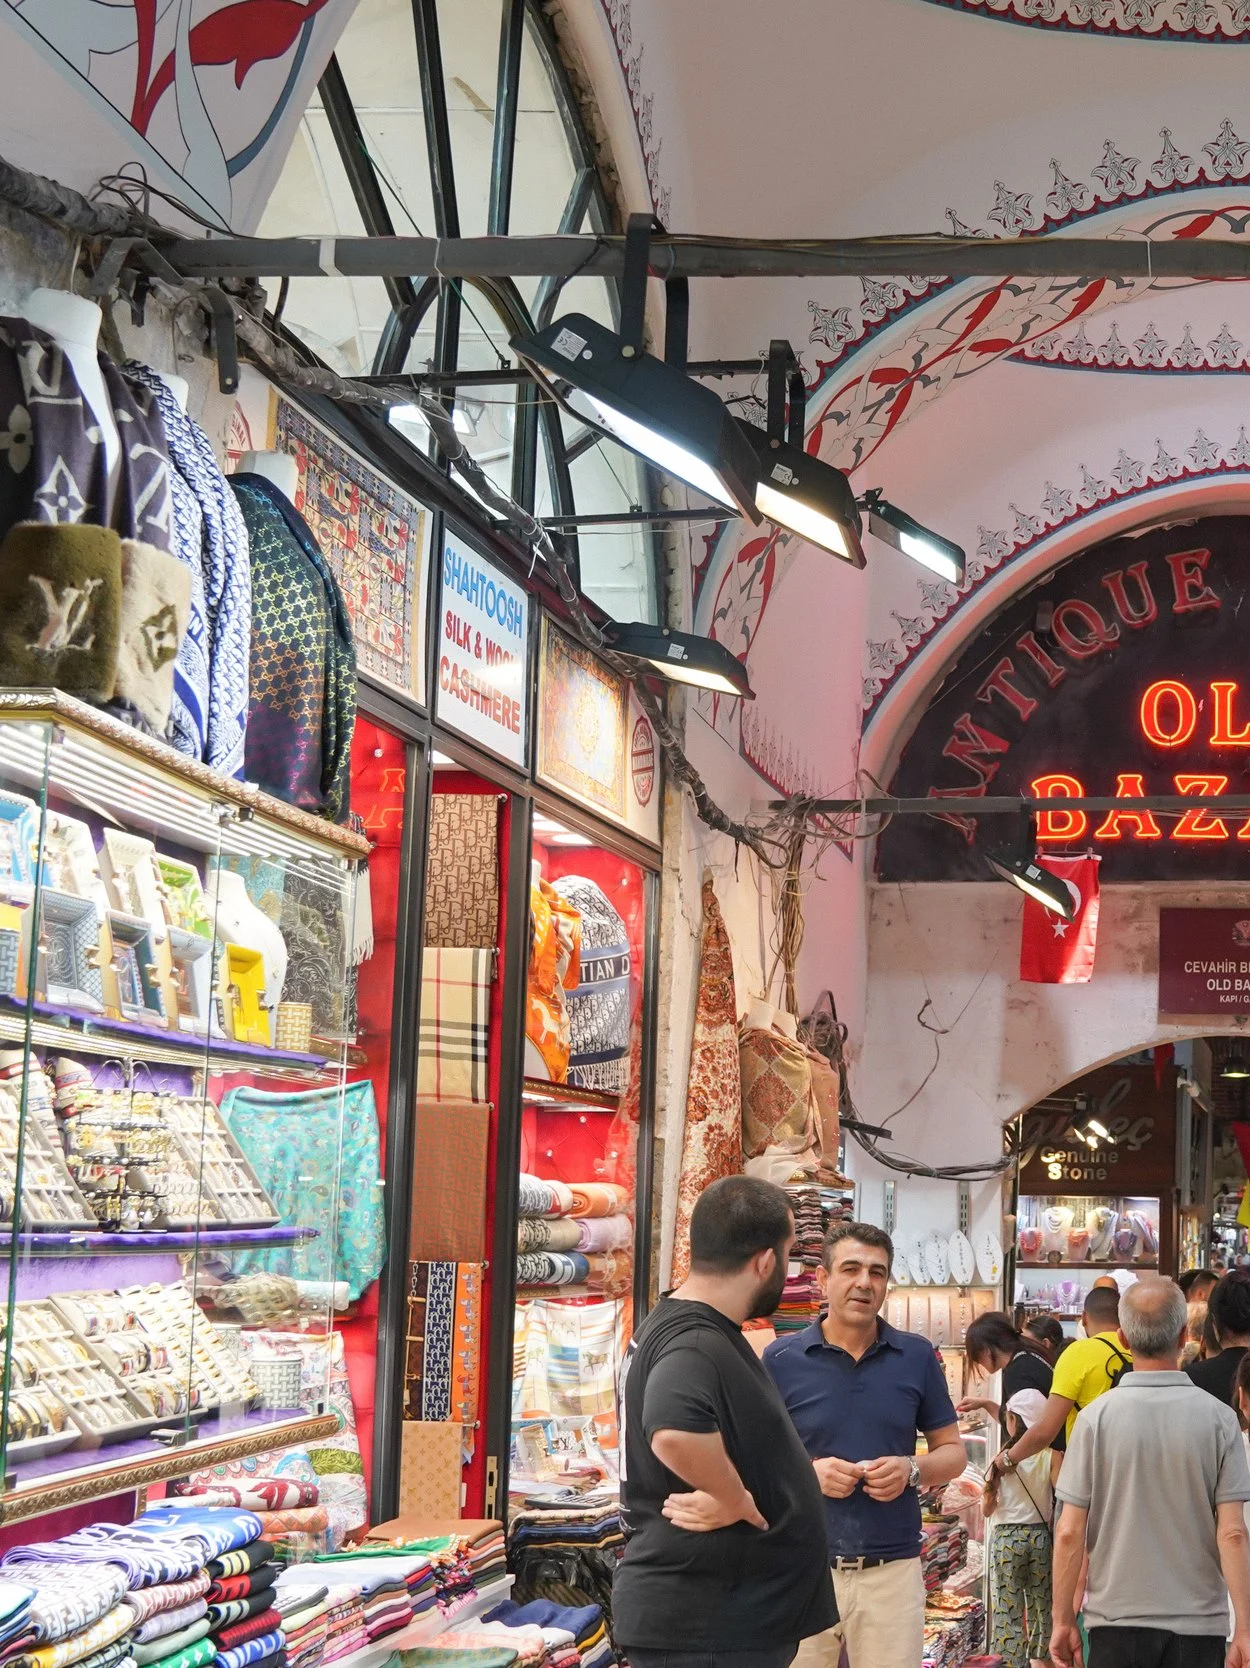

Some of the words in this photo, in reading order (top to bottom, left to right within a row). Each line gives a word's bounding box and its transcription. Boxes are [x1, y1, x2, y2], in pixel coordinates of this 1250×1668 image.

[443, 546, 523, 639] SHAHTOOSH
[445, 609, 472, 654] SILK
[474, 631, 482, 660] &
[486, 637, 519, 669] WOO
[439, 655, 521, 735] CASHMERE
[927, 548, 1221, 845] ANTIQUE
[1184, 959, 1236, 974] CEVAHİR
[1206, 979, 1231, 991] OLD
[1219, 995, 1238, 1003] KAPI
[1040, 1146, 1119, 1165] Genuine
[1047, 1162, 1107, 1181] Stone
